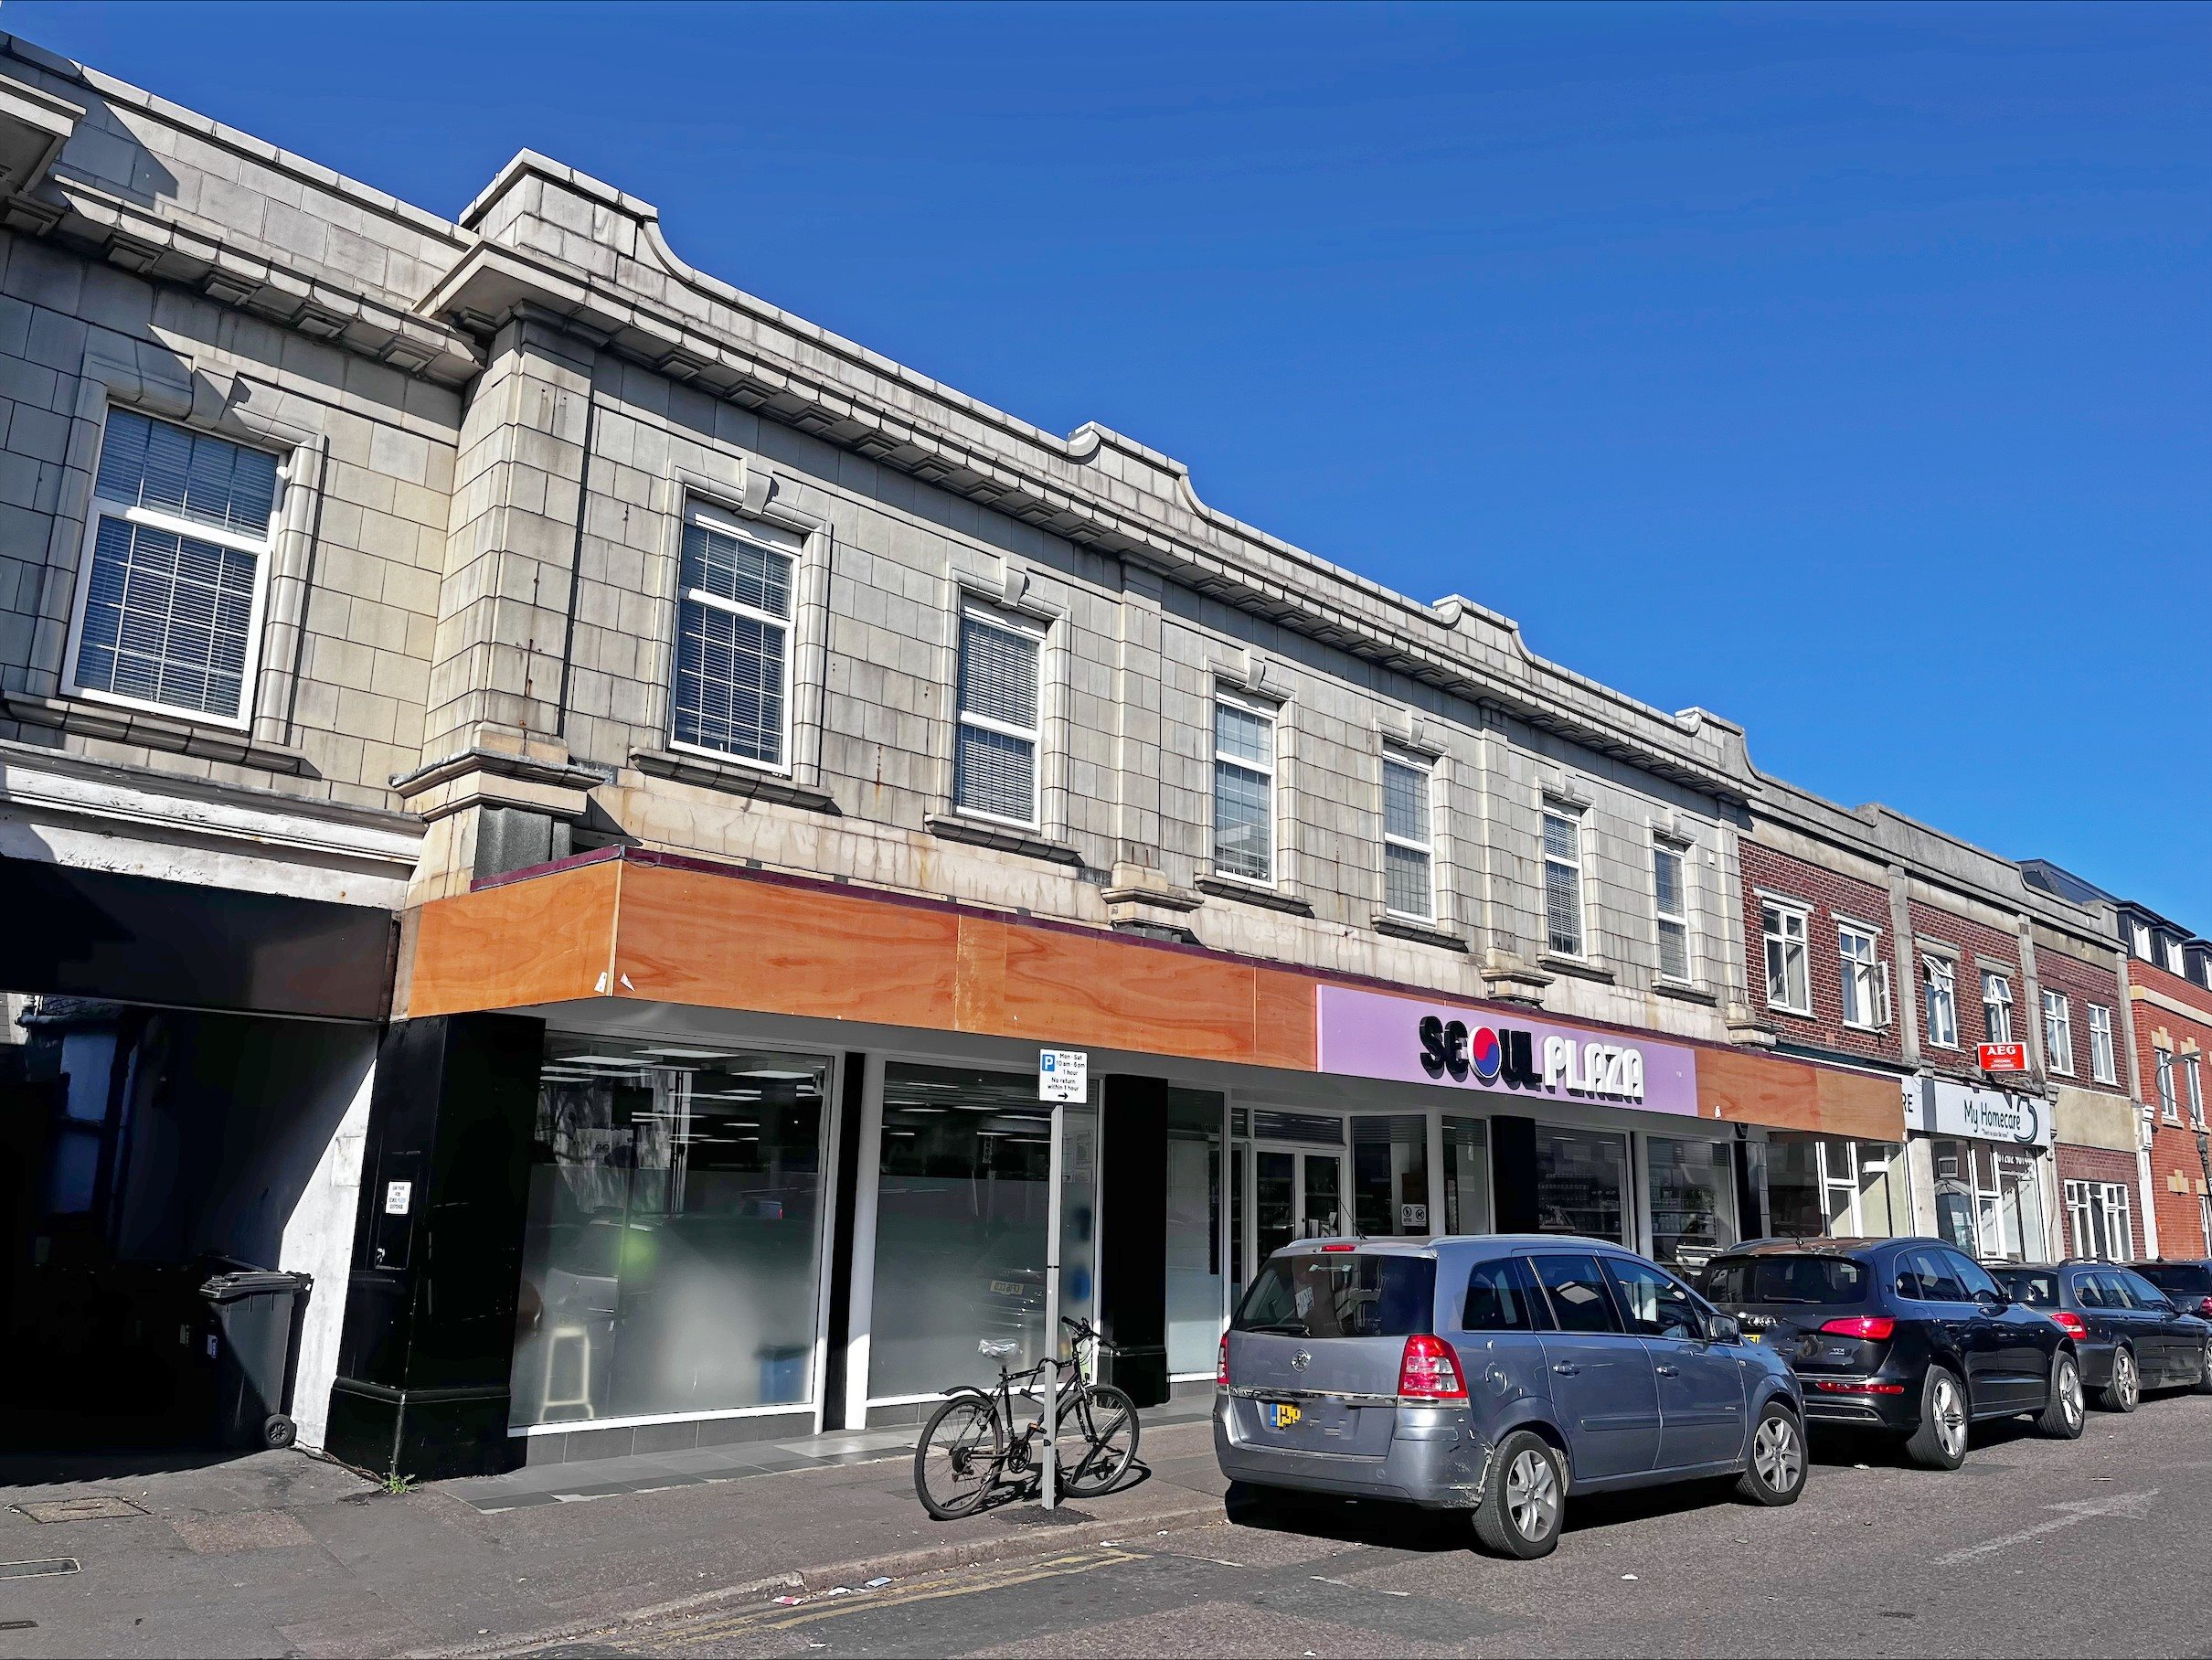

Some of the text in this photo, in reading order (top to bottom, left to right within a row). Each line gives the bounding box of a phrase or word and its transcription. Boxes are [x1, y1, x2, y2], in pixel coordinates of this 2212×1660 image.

[1420, 1016, 1644, 1100] SEOUL PLAZA
[1987, 1045, 2015, 1055] AEG
[1044, 1056, 1053, 1069] P
[1963, 1099, 2021, 1133] My Homecare
